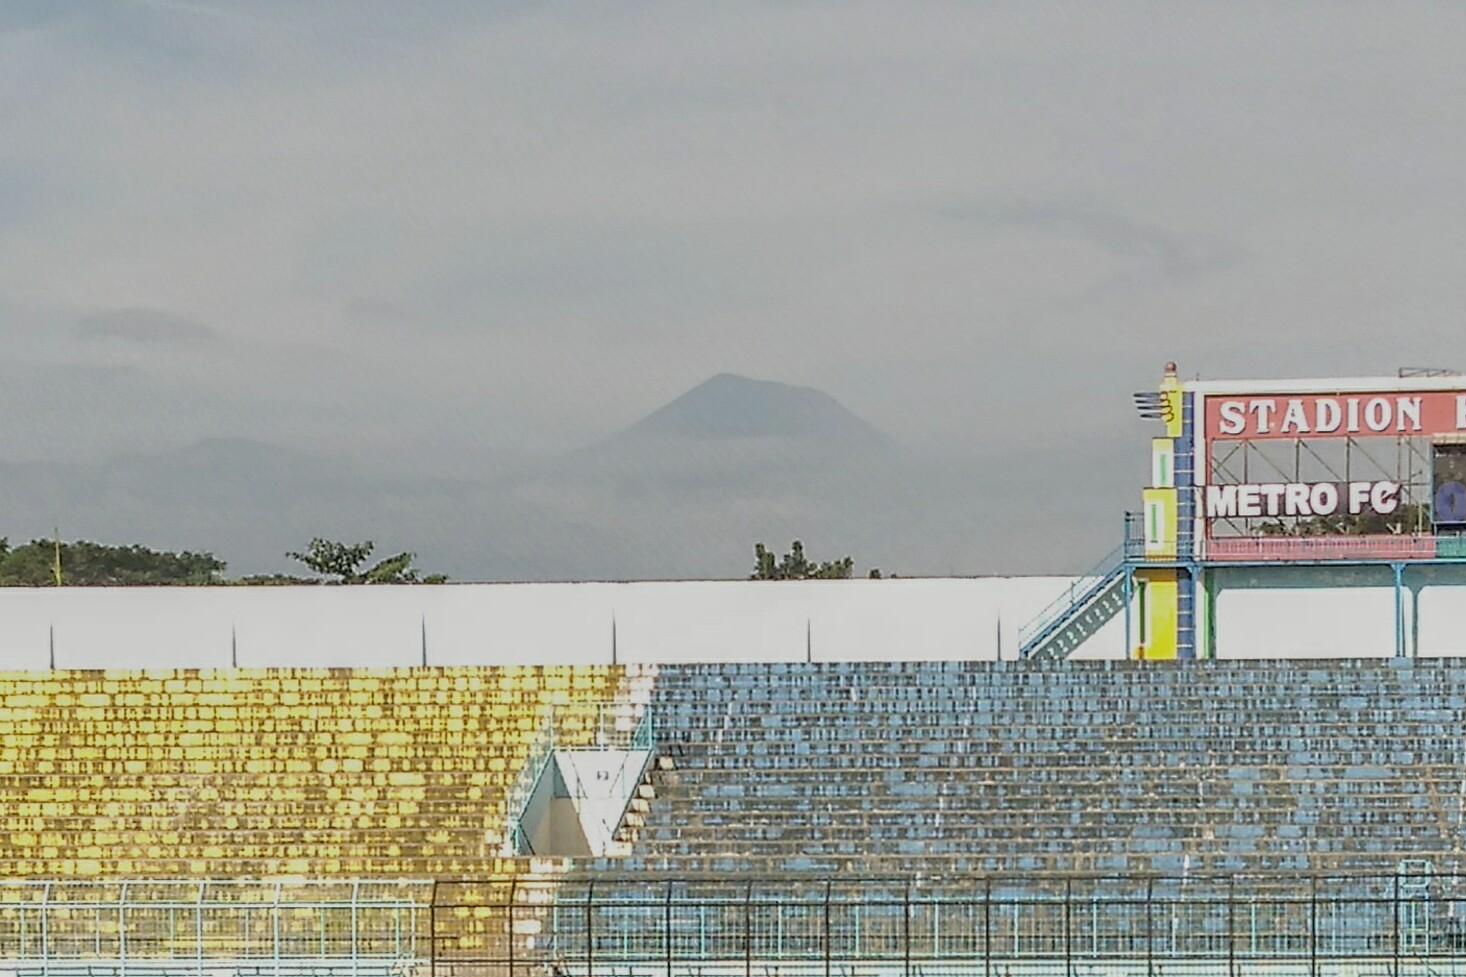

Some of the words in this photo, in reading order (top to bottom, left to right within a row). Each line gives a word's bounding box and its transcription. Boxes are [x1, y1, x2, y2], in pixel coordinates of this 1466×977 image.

[1219, 397, 1423, 435] STADION
[1206, 482, 1339, 518] METRO
[1349, 480, 1402, 515] FC
